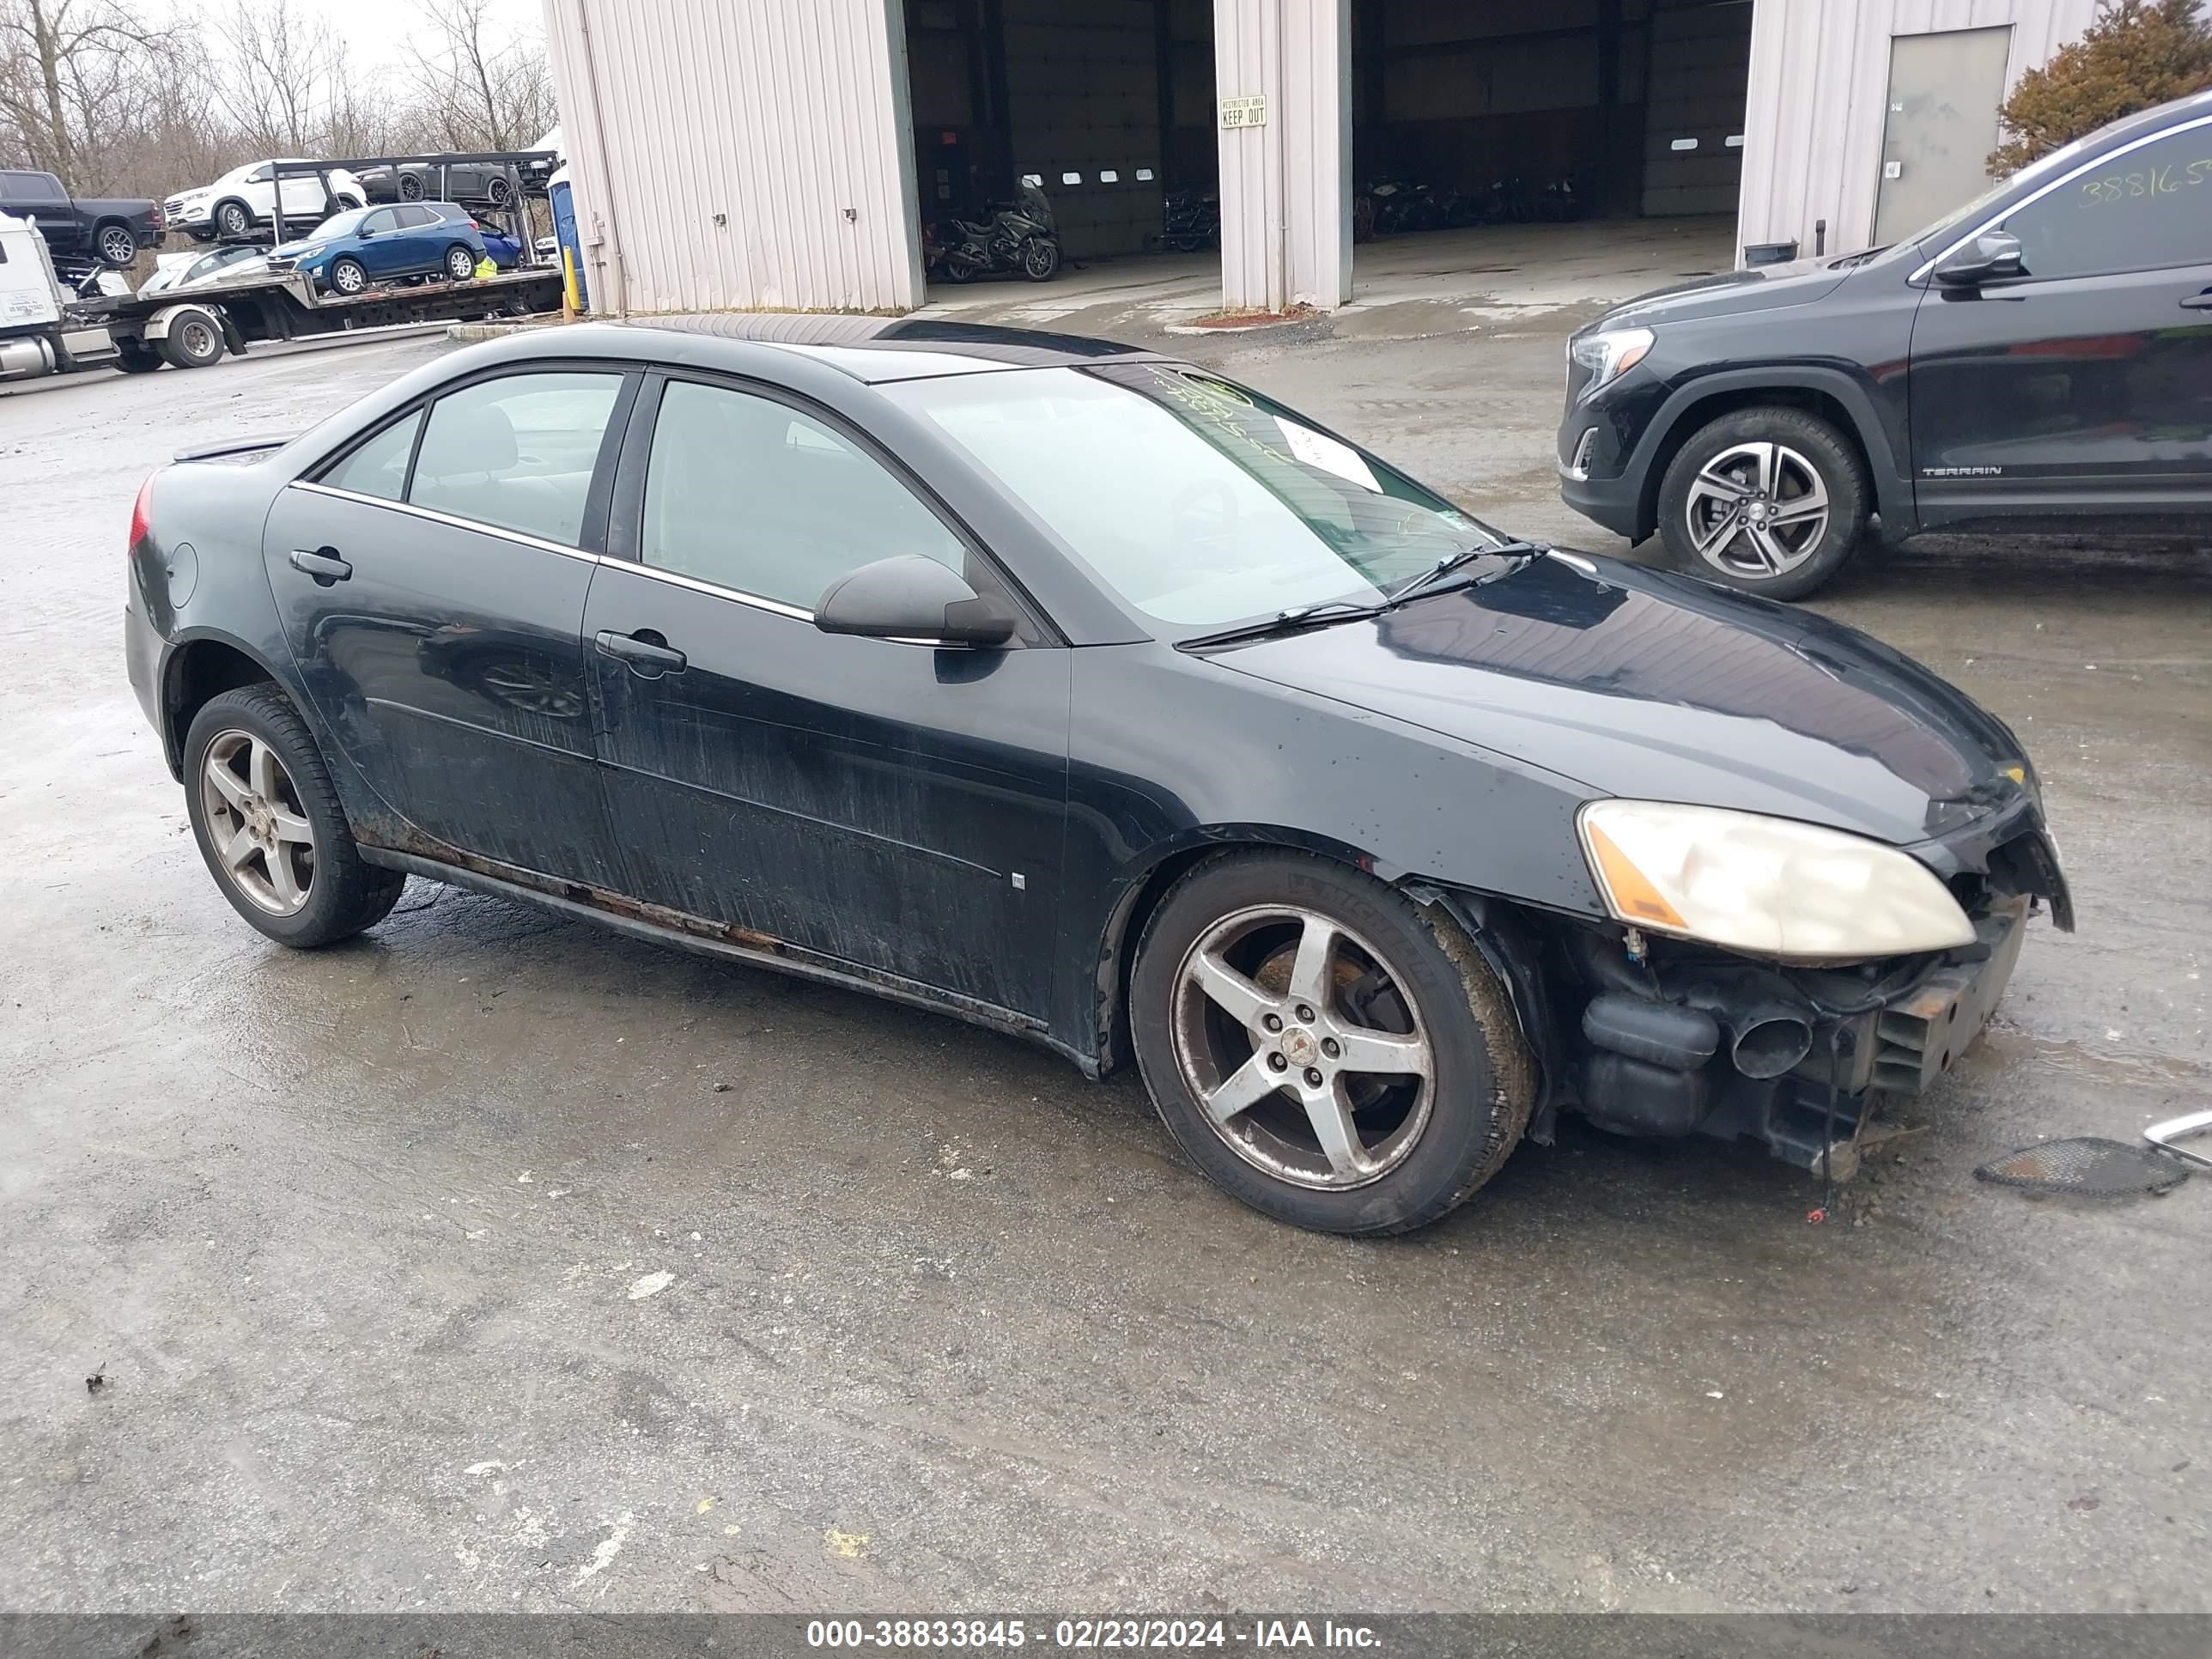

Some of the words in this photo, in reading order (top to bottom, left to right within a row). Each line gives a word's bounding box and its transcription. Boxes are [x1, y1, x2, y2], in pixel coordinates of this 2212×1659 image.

[1223, 99, 1249, 109] RESTRICTED
[1252, 97, 1264, 106] AREA
[1223, 109, 1243, 125] KEEP
[1249, 107, 1264, 123] OUT
[2079, 159, 2212, 208] 388165
[1922, 467, 2002, 476] TERRAIN
